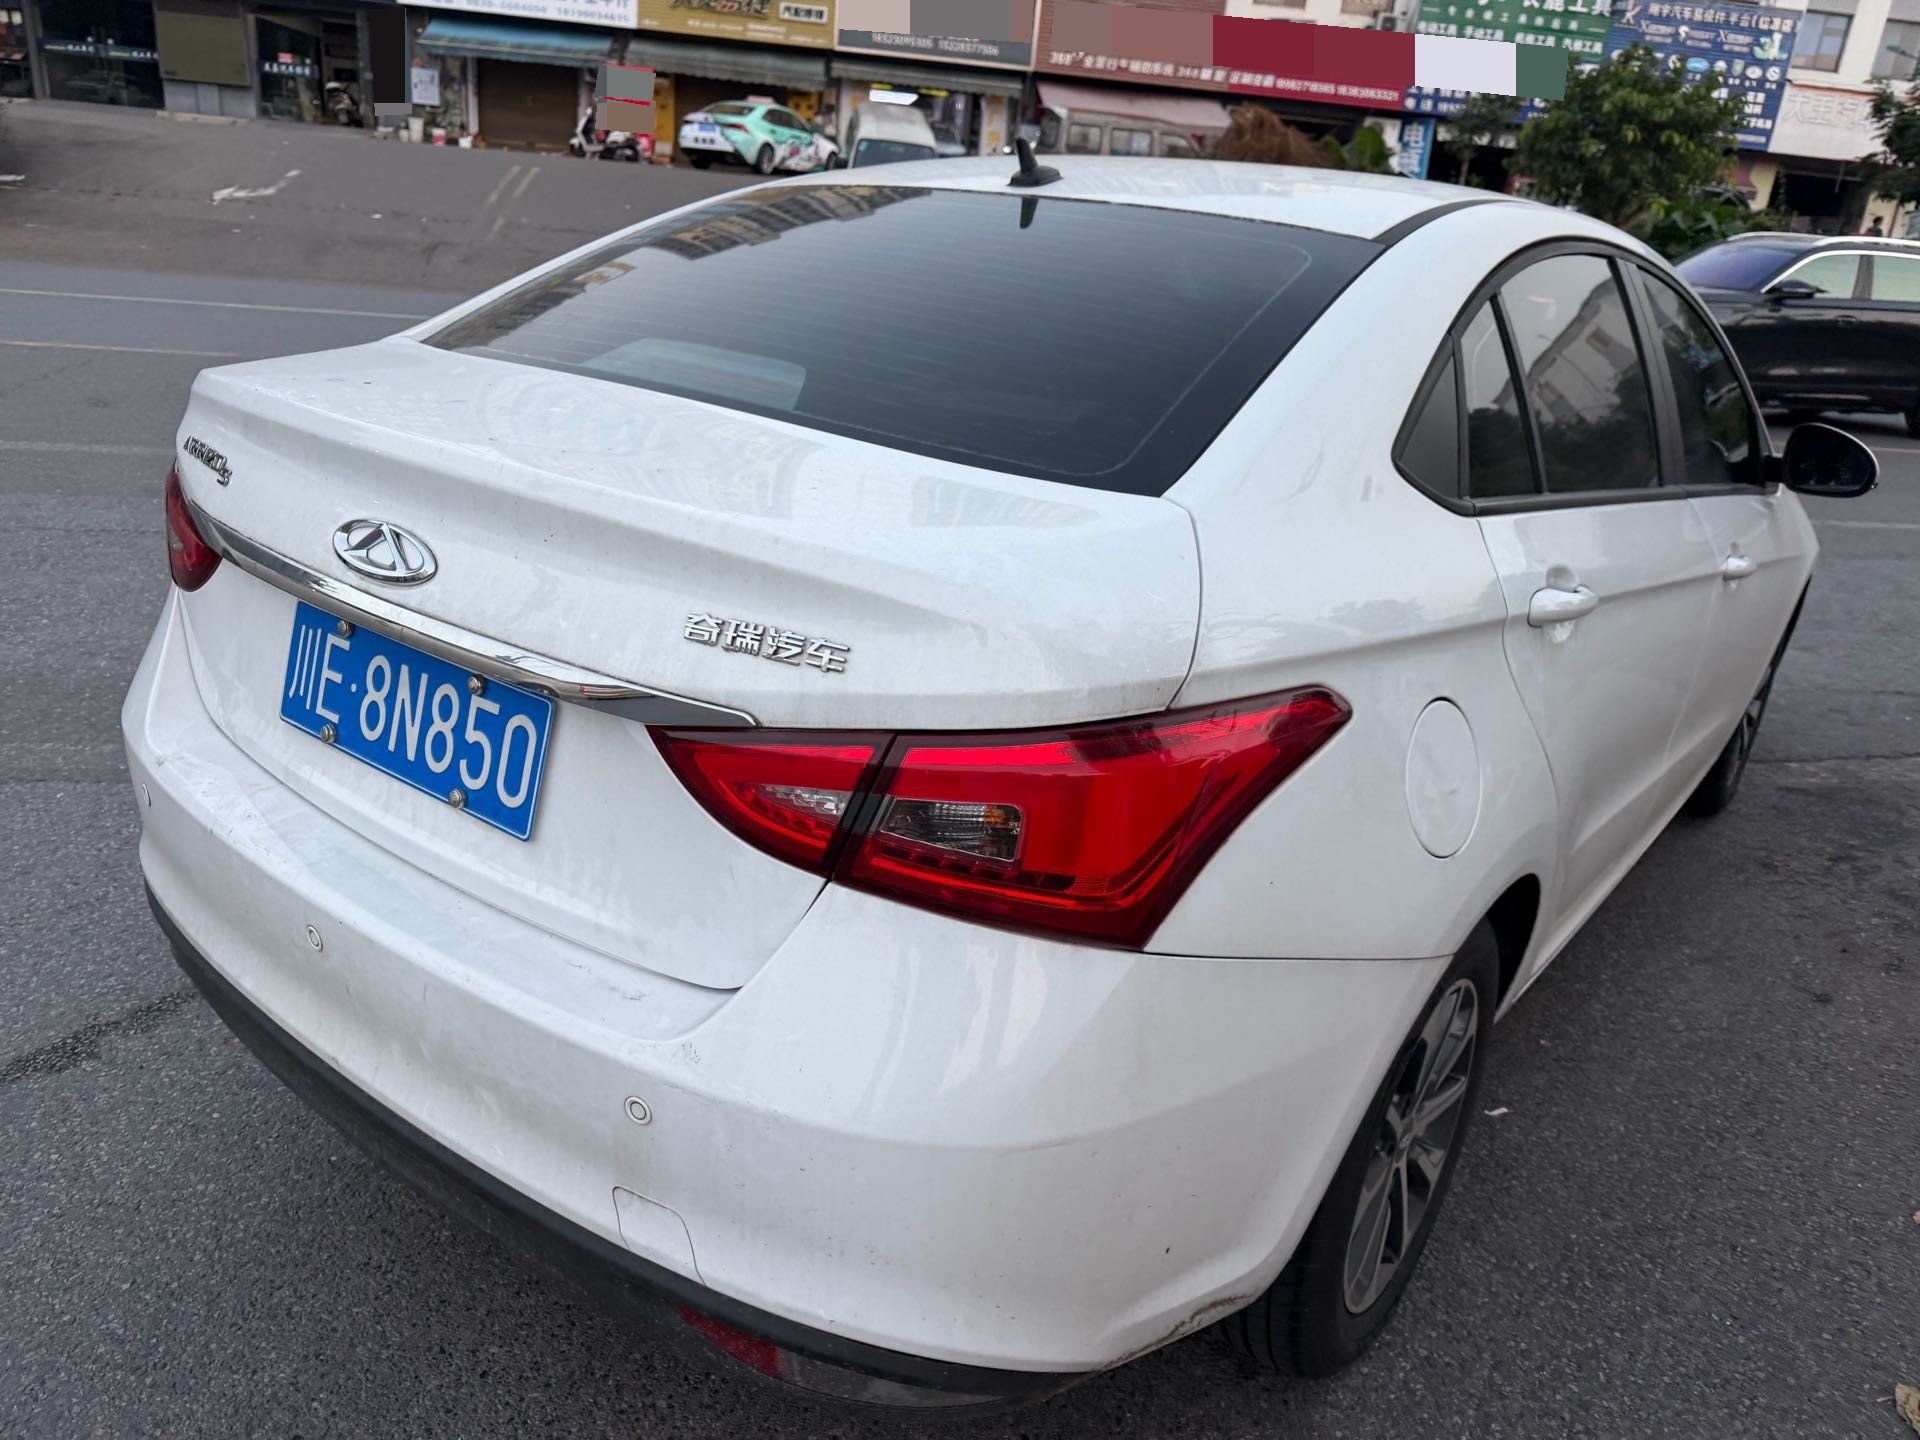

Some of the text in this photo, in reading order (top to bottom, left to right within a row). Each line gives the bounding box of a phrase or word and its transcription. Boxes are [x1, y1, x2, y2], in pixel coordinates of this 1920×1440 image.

[684, 613, 851, 673] 奇瑞汽车
[289, 624, 537, 809] 川E·8N850
